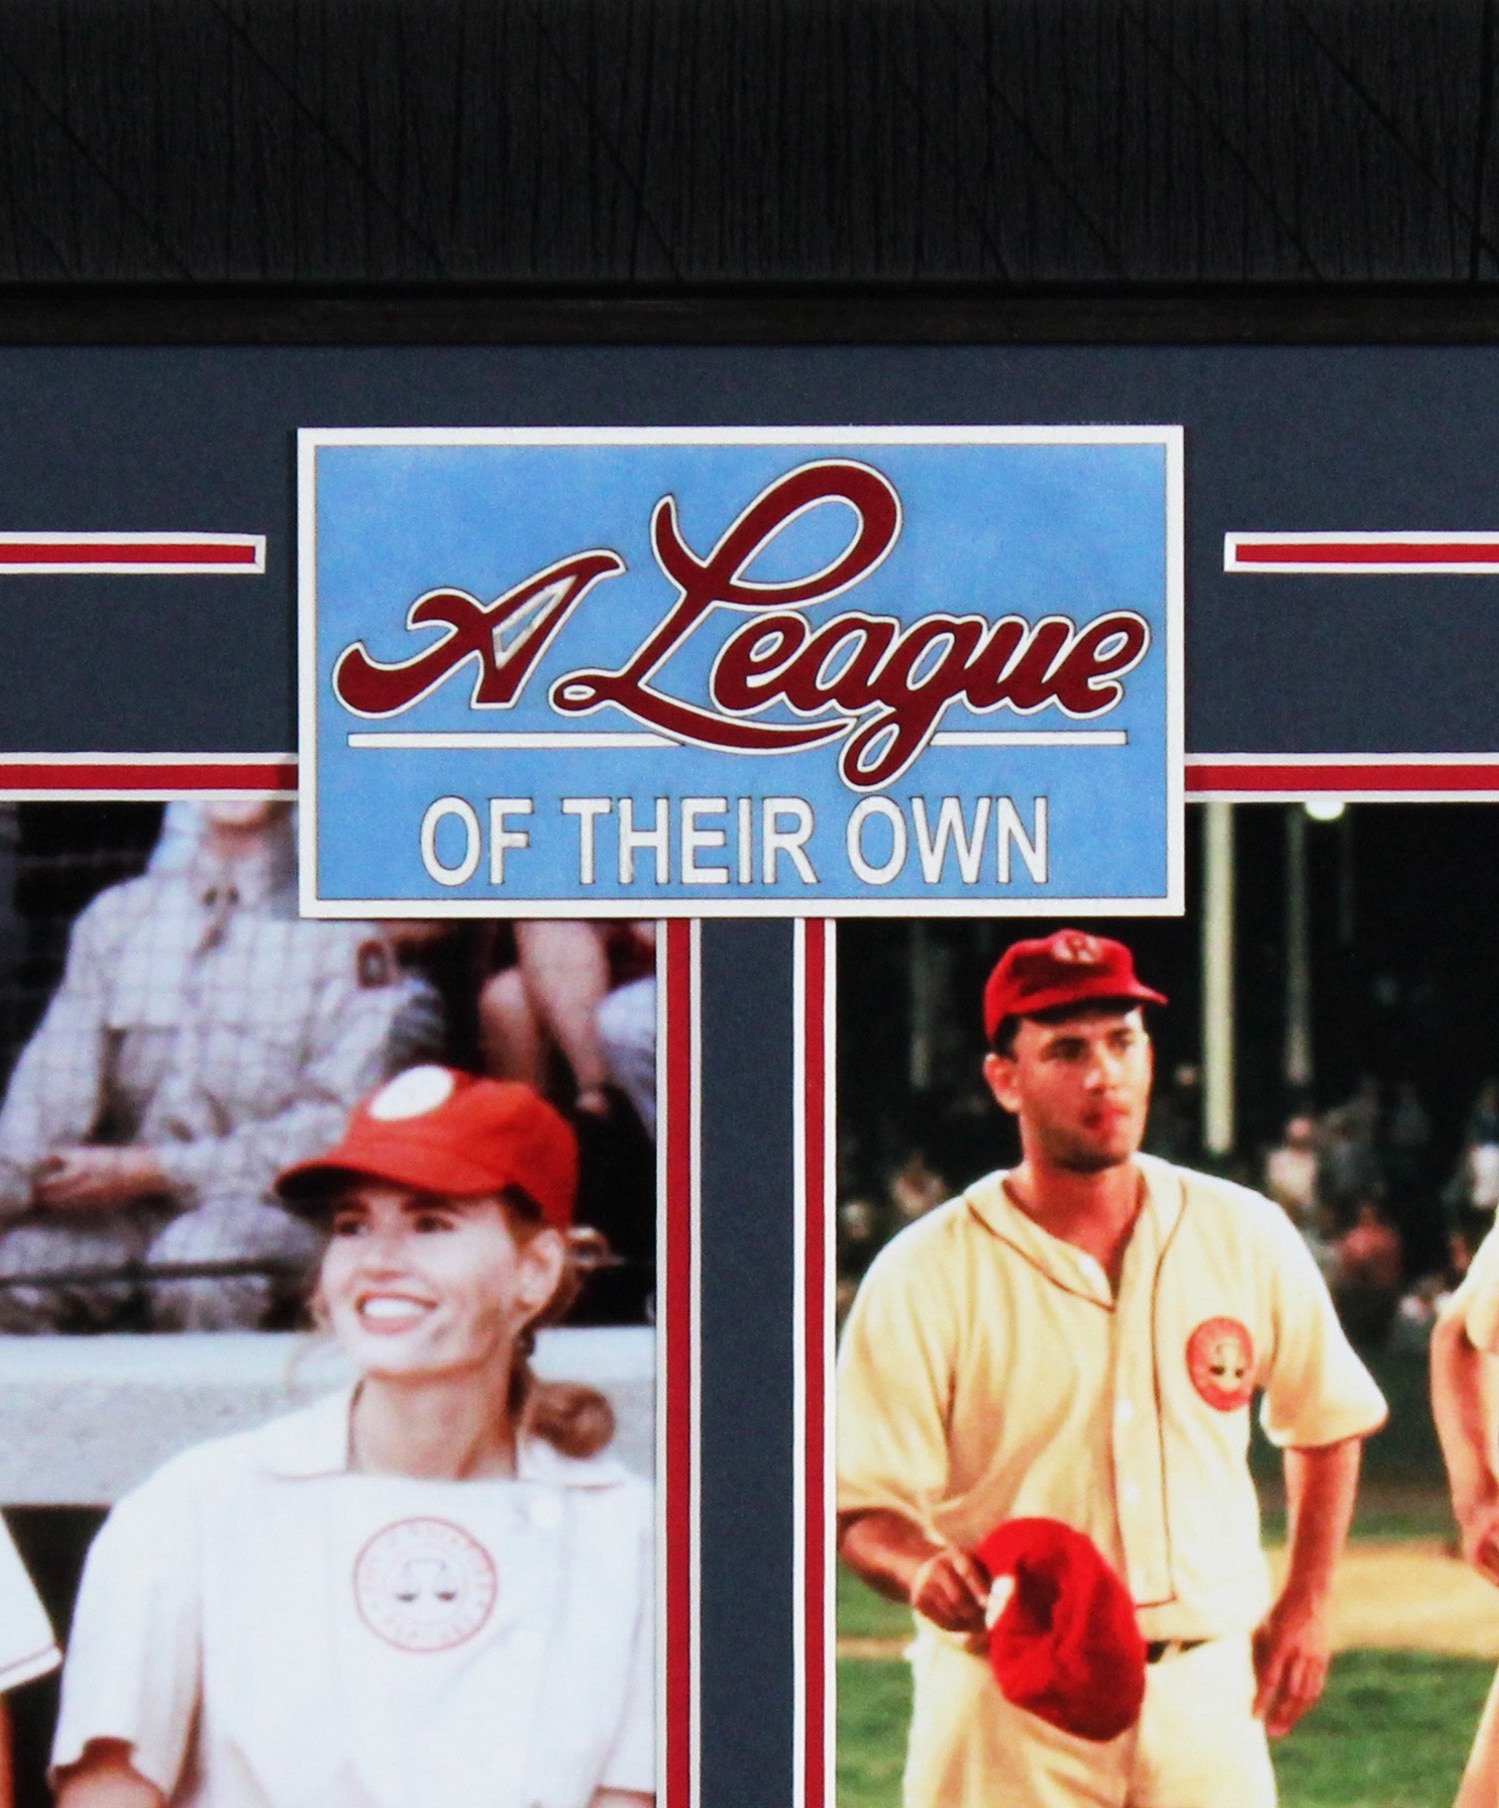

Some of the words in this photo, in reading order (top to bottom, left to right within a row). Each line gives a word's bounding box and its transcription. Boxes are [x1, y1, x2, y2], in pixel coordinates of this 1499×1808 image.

[334, 550, 625, 716] A
[549, 458, 1152, 791] League
[420, 796, 533, 886] OF
[561, 796, 819, 886] THEIR
[846, 796, 1048, 886] OWN
